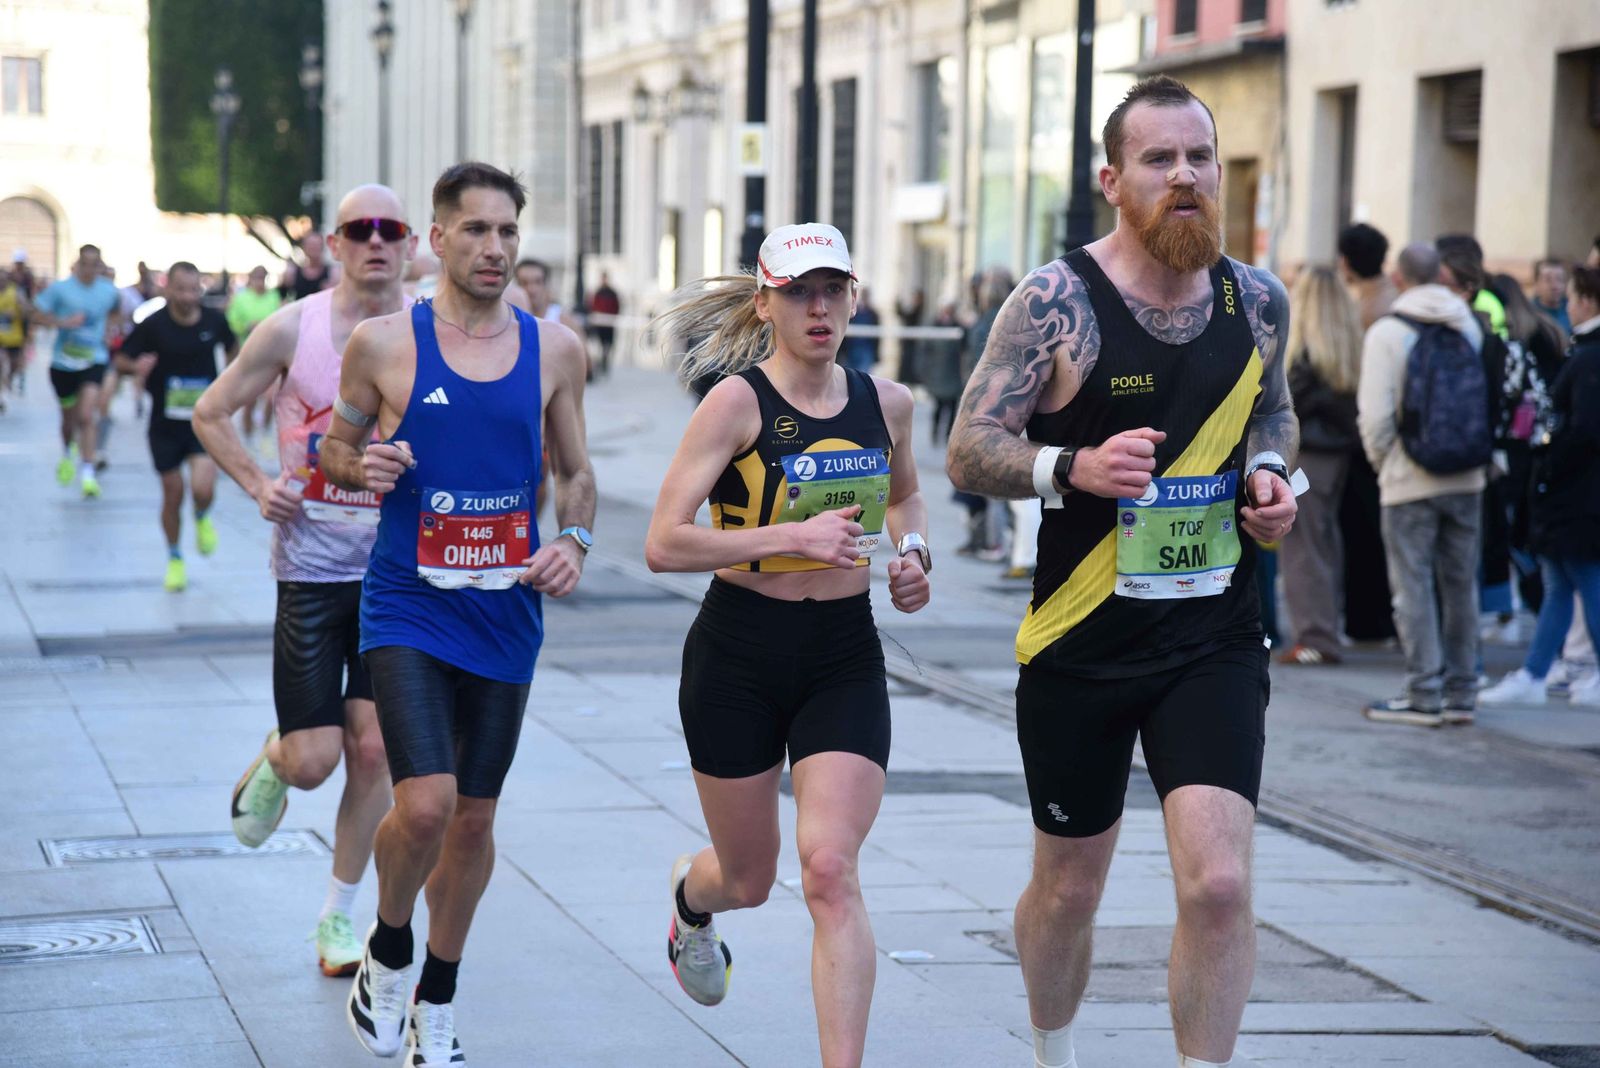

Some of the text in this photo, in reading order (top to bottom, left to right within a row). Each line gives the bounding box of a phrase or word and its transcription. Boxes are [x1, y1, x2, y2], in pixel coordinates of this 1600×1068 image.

[783, 235, 834, 250] TIMEX
[1222, 276, 1235, 316] soar
[1111, 373, 1154, 389] POOLE
[1112, 388, 1139, 396] ATHLETIC
[823, 456, 877, 473] ZURICH
[323, 482, 380, 505] KAMIL
[824, 490, 855, 506] 3159
[1167, 480, 1226, 500] ZURICH
[461, 495, 520, 511] ZURICH
[462, 526, 494, 540] 1445
[1169, 520, 1204, 537] 1708
[444, 543, 506, 566] OIHAN
[1159, 542, 1207, 569] SAM
